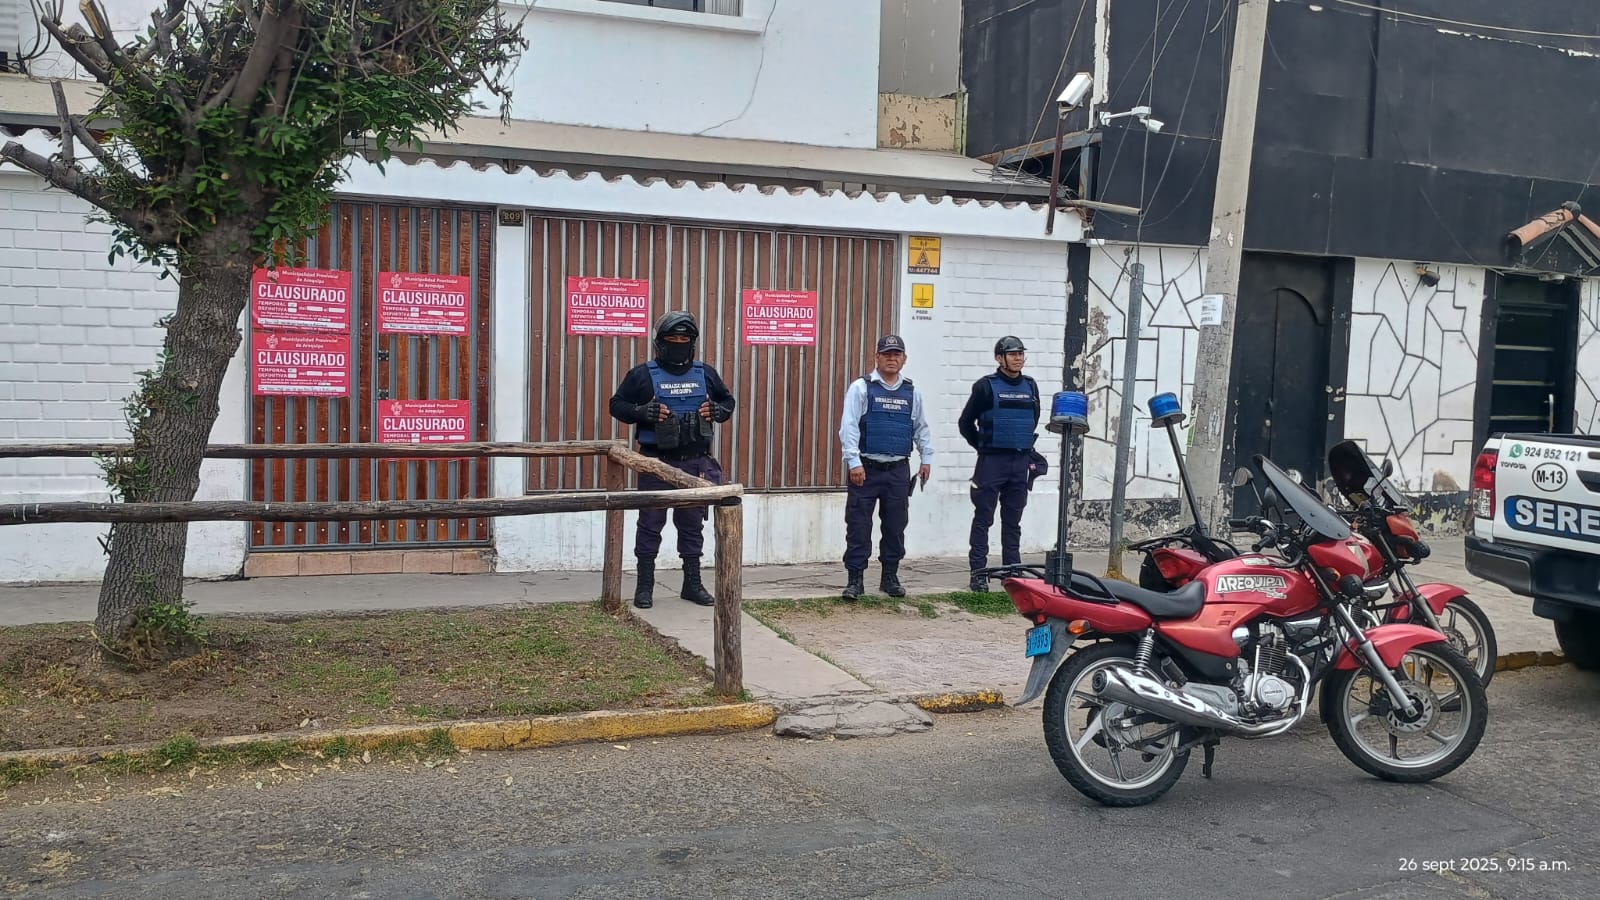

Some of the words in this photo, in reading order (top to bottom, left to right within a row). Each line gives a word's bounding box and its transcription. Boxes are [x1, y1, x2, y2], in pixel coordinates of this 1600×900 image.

[258, 284, 345, 302] CLAUSURADO
[383, 291, 464, 306] CLAUSURADO
[571, 294, 644, 308] CLAUSURADO
[747, 306, 813, 319] CLAUSURADO
[258, 352, 345, 366] CLAUSURADO
[384, 418, 464, 430] CLAUSURADO
[1525, 446, 1541, 457] 924
[1544, 448, 1561, 459] 852
[1565, 451, 1582, 461] 121
[1501, 462, 1527, 470] TOYOTA
[1536, 470, 1563, 484] M-13
[1216, 576, 1287, 592] AREQUIPA
